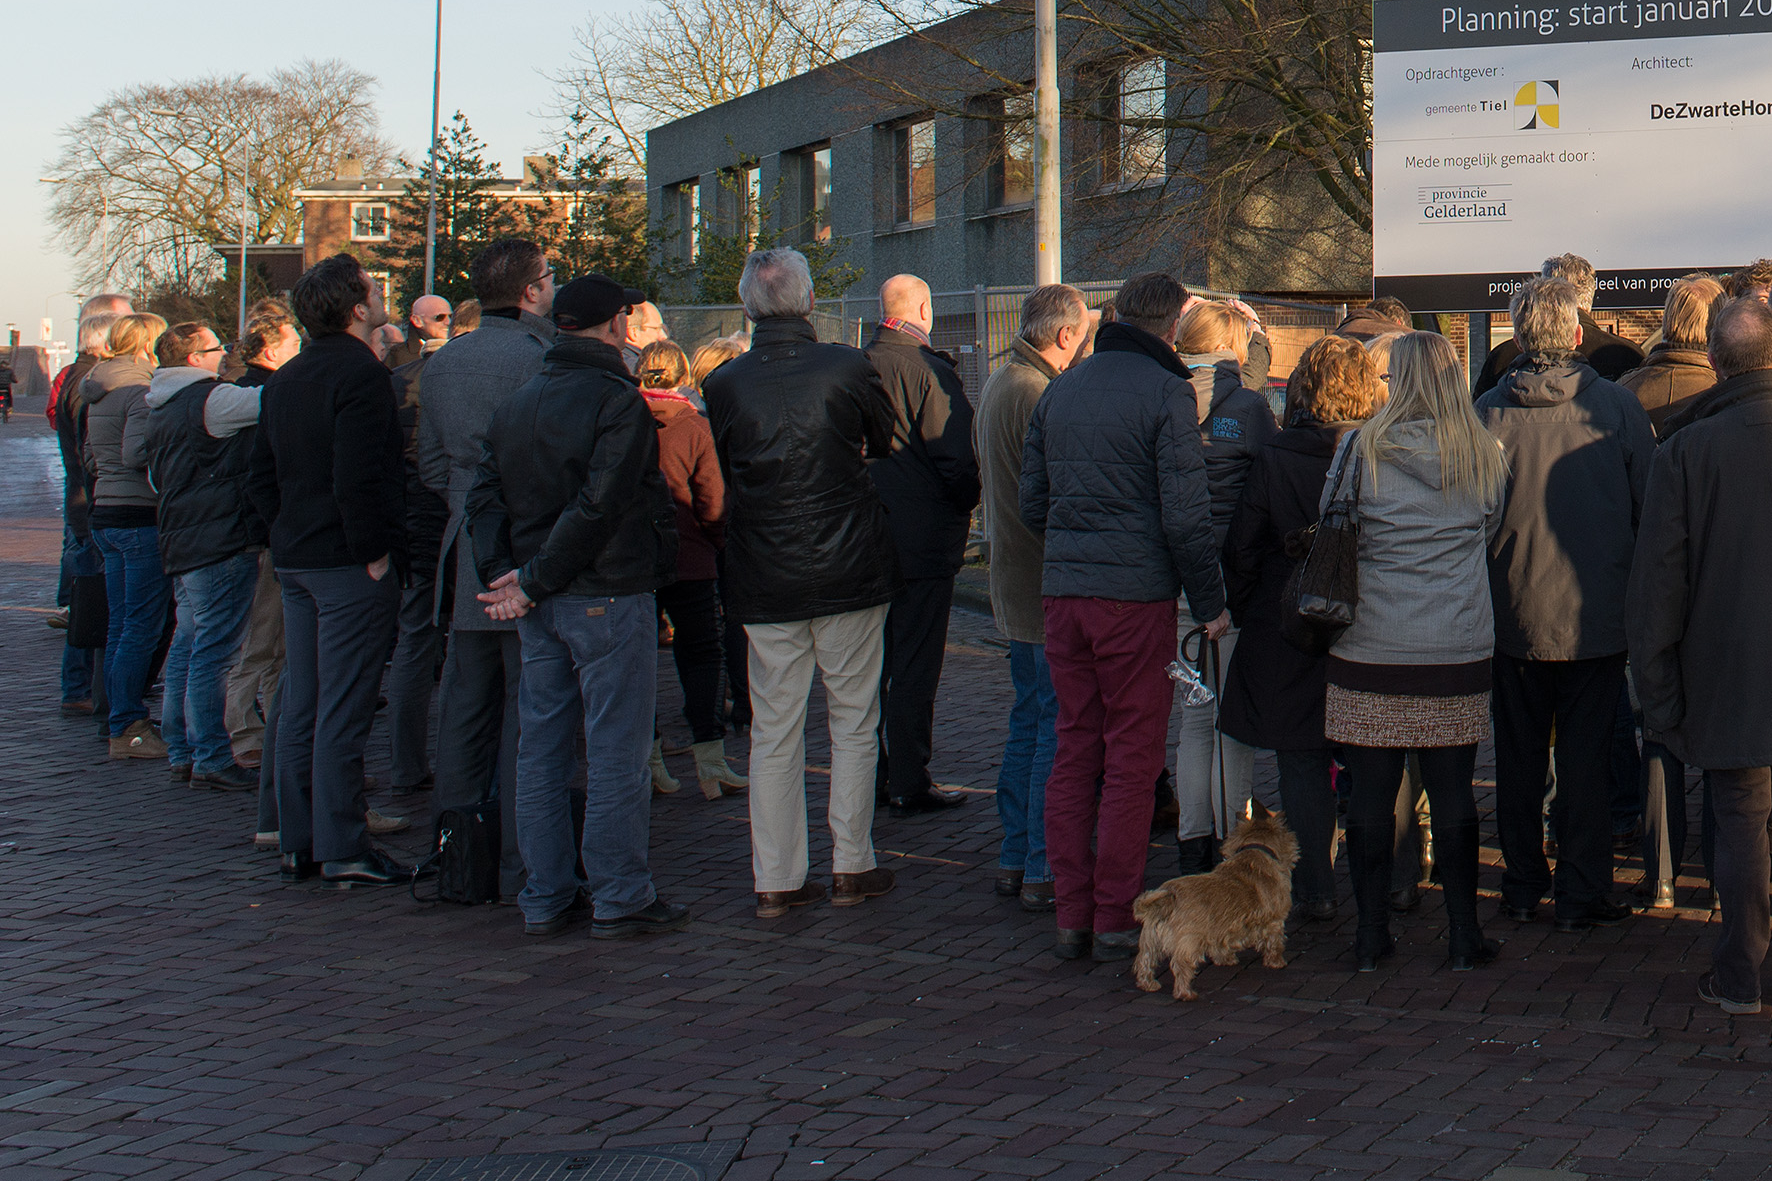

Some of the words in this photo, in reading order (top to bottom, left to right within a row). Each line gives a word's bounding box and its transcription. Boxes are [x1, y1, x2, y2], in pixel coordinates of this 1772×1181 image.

[1443, 5, 1559, 35] Planning:
[1569, 1, 1627, 25] start
[1631, 55, 1693, 70] Architect:
[1406, 67, 1498, 83] Opdrachtgever
[1425, 103, 1477, 116] gemeente
[1480, 100, 1506, 111] Tiel
[1406, 156, 1440, 168] Mede
[1444, 153, 1497, 169] mogelijk
[1501, 151, 1554, 168] gemaakt
[1559, 150, 1588, 162] door
[1432, 187, 1487, 202] provincie
[1424, 203, 1507, 219] Gelderland
[1622, 279, 1646, 289] van
